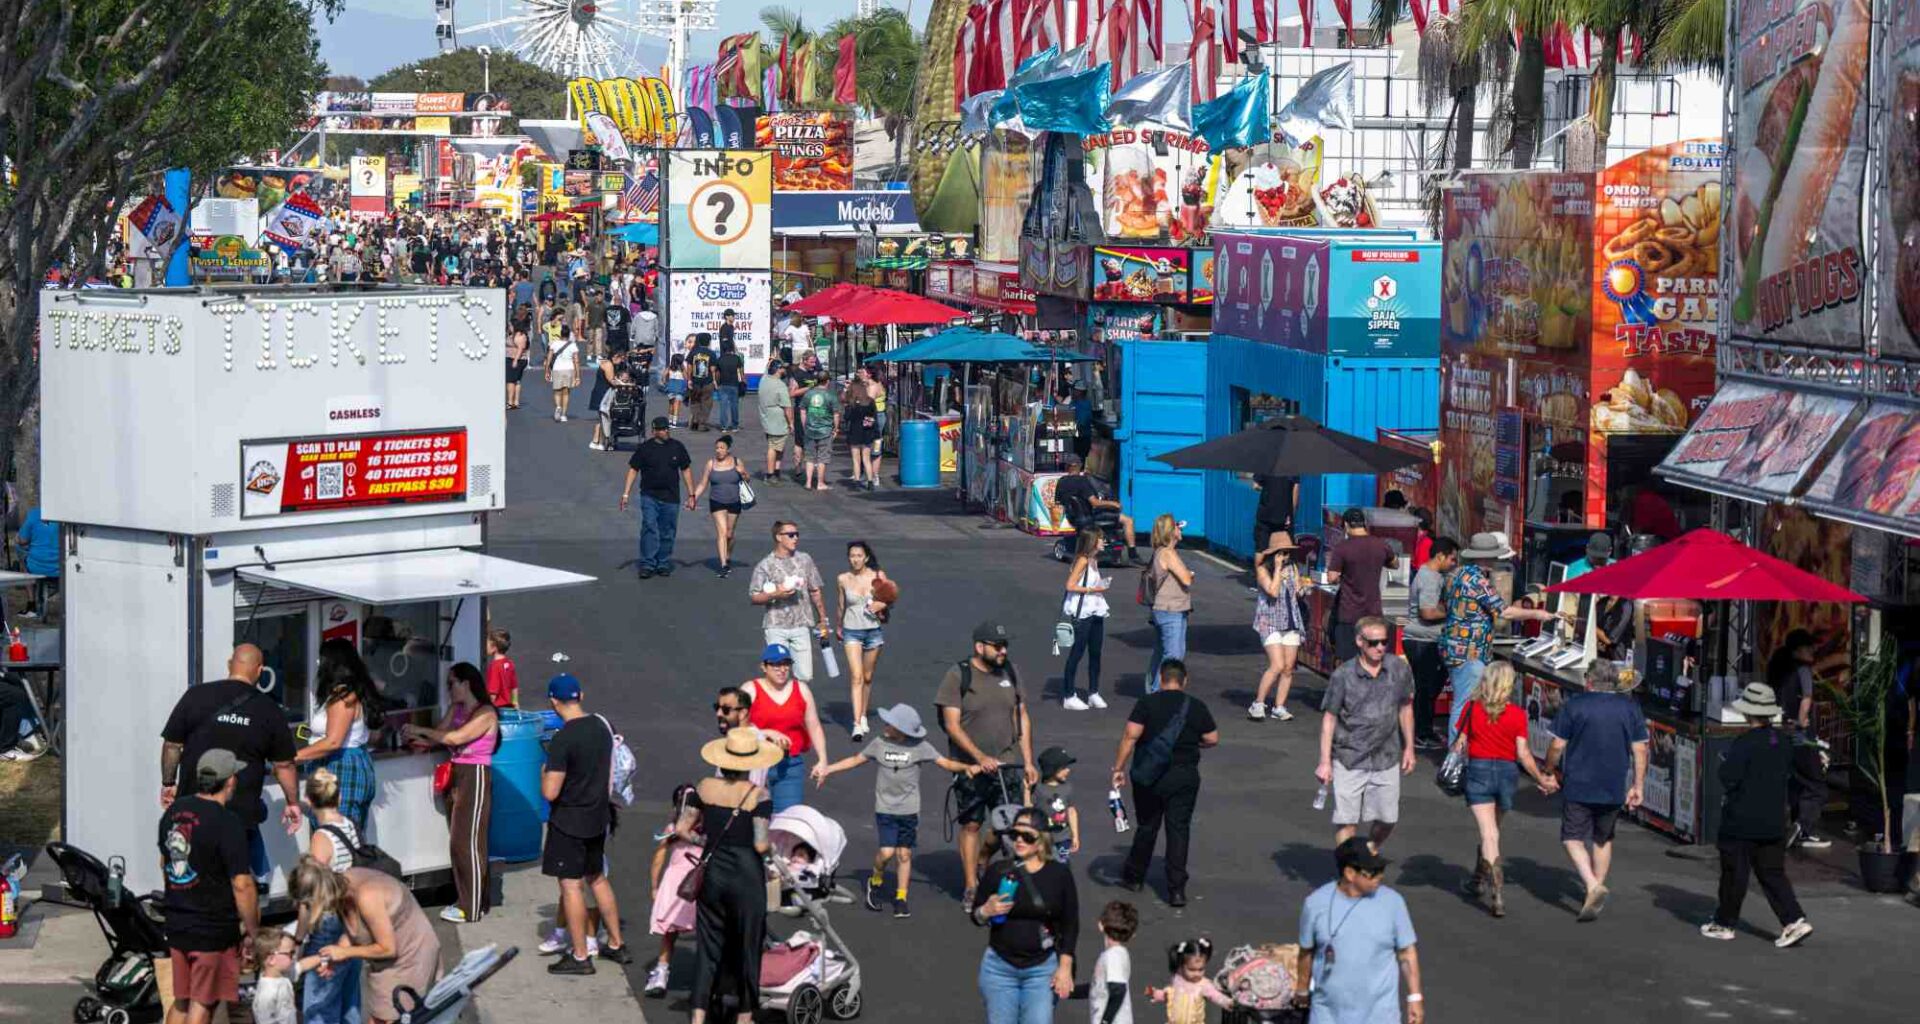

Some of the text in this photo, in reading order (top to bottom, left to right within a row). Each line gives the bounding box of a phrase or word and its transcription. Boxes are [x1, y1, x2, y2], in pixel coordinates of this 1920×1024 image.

[419, 95, 447, 104] Guest
[775, 125, 827, 139] PIZZA
[1141, 128, 1211, 154] SRIMP
[779, 143, 825, 158] WINGS
[1686, 143, 1728, 154] FRES
[693, 158, 754, 177] INFO
[1672, 157, 1722, 167] POTAT
[1604, 185, 1650, 195] ONION
[1614, 197, 1658, 207] RINGS
[838, 201, 894, 222] Modelo
[698, 282, 745, 299] $5 Taste
[1005, 281, 1020, 289] UNC
[1758, 248, 1860, 333] HOT DOGS
[725, 291, 746, 299] Fair
[691, 312, 752, 320] TREAT YOSELF
[1106, 316, 1139, 329] PARTY
[1373, 312, 1396, 320] BAJA
[48, 309, 184, 354] TICKETS
[1368, 320, 1400, 330] SIPPER
[211, 296, 492, 371] TICKETS
[1451, 385, 1491, 413] GARLIC
[329, 408, 381, 420] CASHLESS
[296, 441, 361, 454] SCAN TO PLAN
[373, 437, 450, 451] 4 TICKETS $5
[367, 451, 457, 467] 16 TICKETS $20
[365, 464, 457, 480] 40 TICKETS $50
[368, 478, 454, 495] FASTPASS $30
